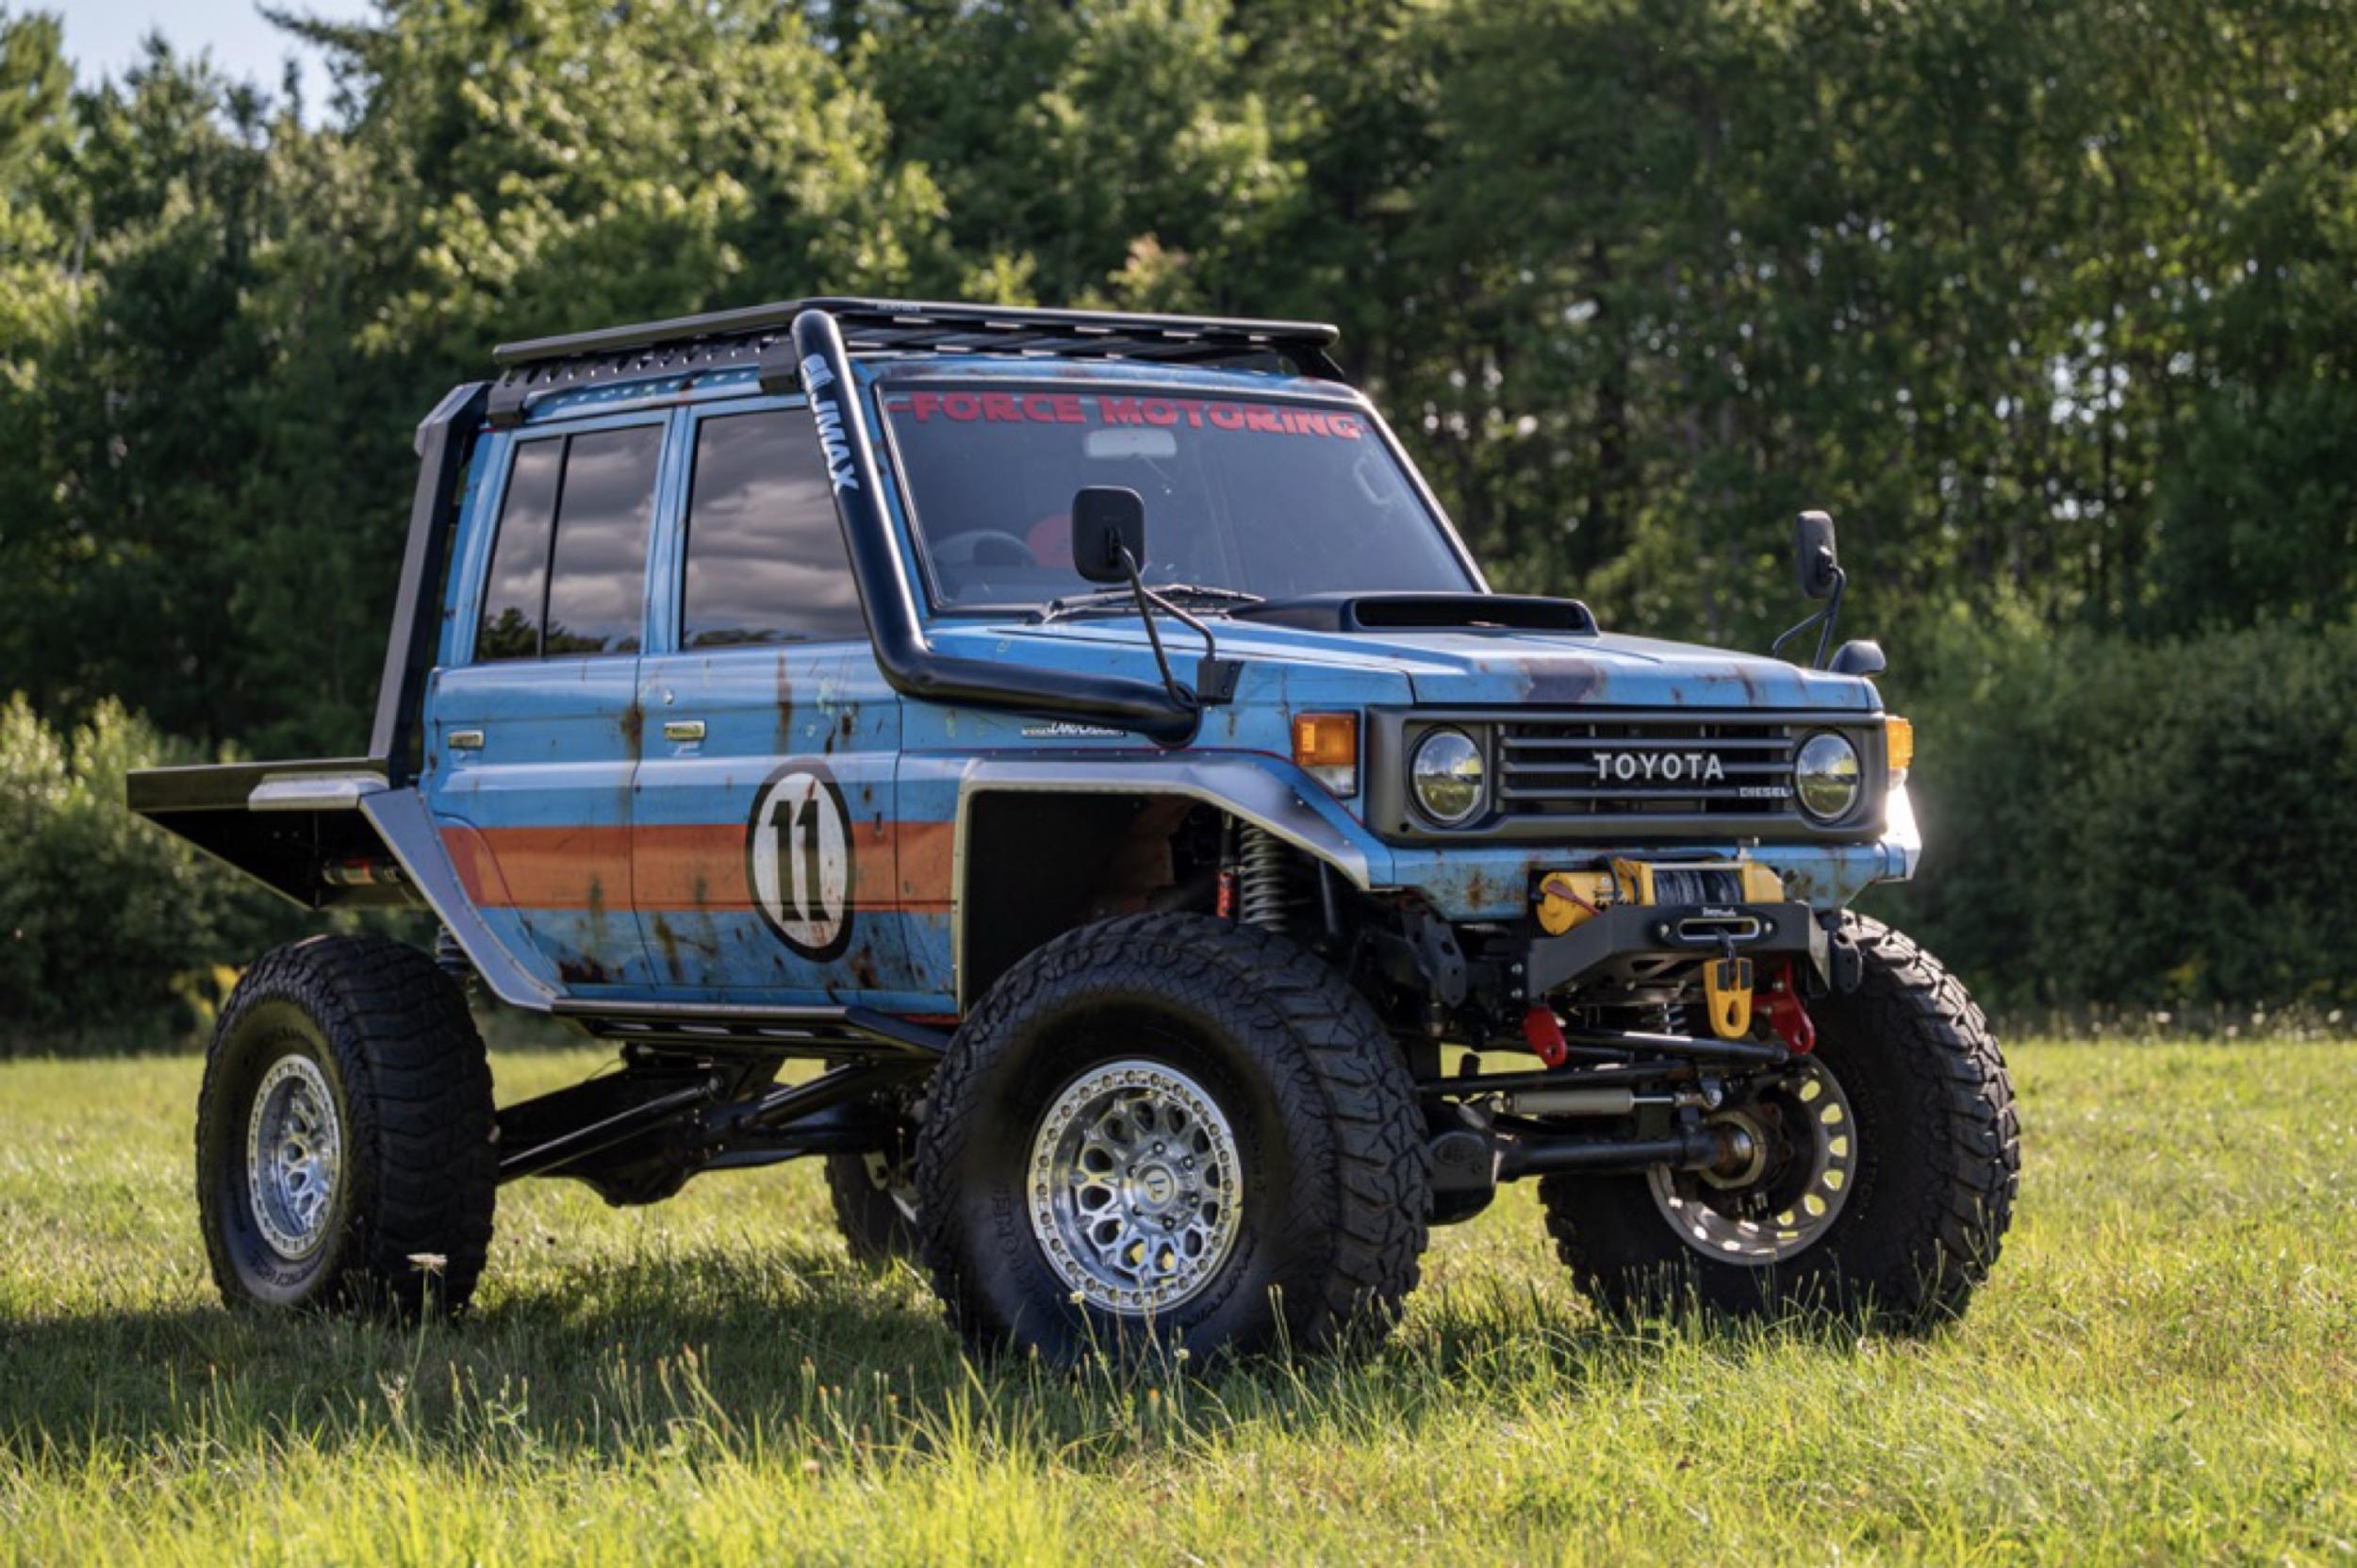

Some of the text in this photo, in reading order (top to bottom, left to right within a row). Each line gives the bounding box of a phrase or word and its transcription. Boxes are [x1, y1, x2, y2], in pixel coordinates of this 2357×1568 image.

[1593, 753, 1724, 781] TOYOTA
[1739, 786, 1789, 798] DIESEL
[768, 801, 831, 921] 11
